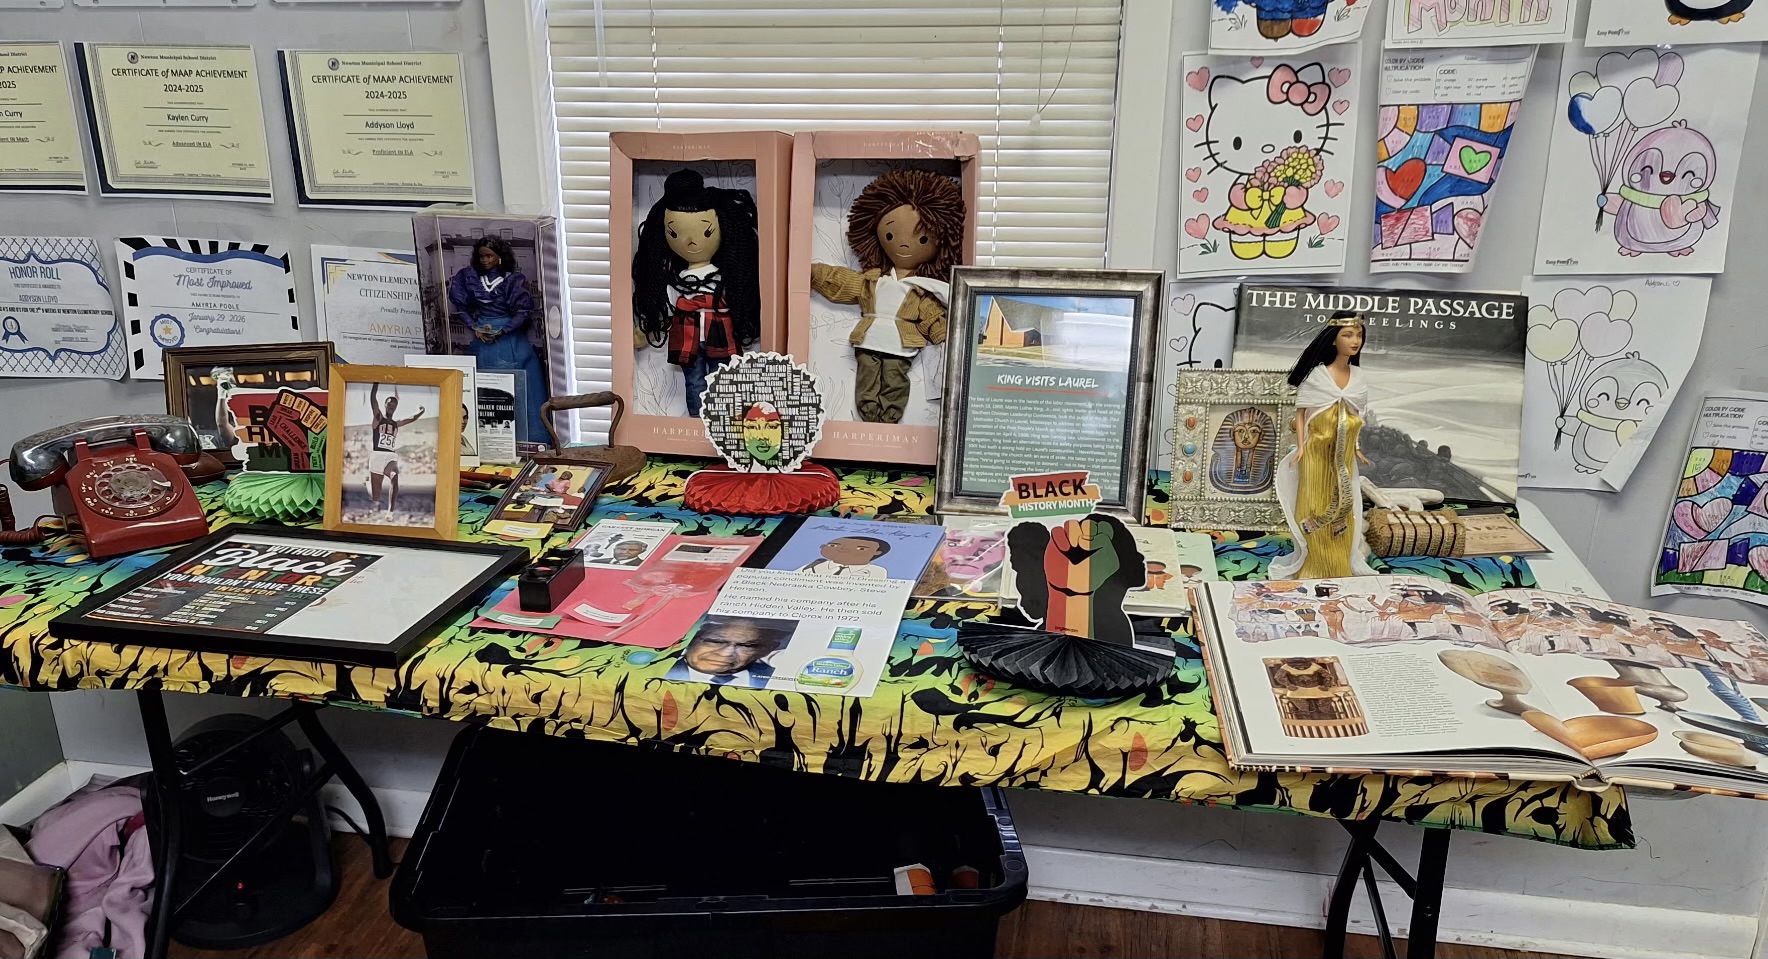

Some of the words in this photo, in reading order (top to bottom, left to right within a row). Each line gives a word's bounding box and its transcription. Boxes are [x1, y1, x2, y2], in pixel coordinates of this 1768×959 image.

[8, 65, 58, 77] ACHIEVEMENT
[111, 68, 159, 77] CERTIFICATE
[161, 69, 169, 79] of
[170, 69, 193, 78] MAAP
[195, 70, 248, 79] ACHIEVEMENT
[311, 75, 360, 84] CERTIFICATE
[362, 75, 371, 86] of
[372, 75, 397, 84] MAAP
[398, 75, 454, 85] ACHIEVEMENT
[163, 84, 204, 93] 2024-2025
[364, 91, 407, 100] 2024-2025
[5, 109, 22, 120] Curry
[166, 113, 189, 123] Kaylen
[190, 114, 209, 124] Curry
[364, 120, 394, 130] Addyson
[396, 120, 415, 130] Lloyd
[9, 266, 38, 280] HONOR
[40, 267, 62, 281] ROLL
[185, 267, 224, 276] CERTIFICATE
[173, 274, 205, 289] Most
[206, 277, 253, 292] Improved
[346, 272, 378, 282] NEWTON
[379, 275, 419, 286] ELEMENTA
[359, 287, 413, 301] CITIZENSHIP
[191, 301, 218, 310] AMYRIA
[219, 303, 240, 311] POOLE
[1246, 289, 1298, 309] THE
[1302, 292, 1401, 314] MIDDLE
[1407, 296, 1517, 321] PASSAGE
[188, 312, 215, 324] January
[228, 314, 246, 323] 2026
[1304, 313, 1327, 323] TO
[1368, 316, 1458, 332] EELINGS
[193, 325, 244, 336] Congratulations!
[368, 323, 413, 336] AMYRIA
[765, 364, 787, 373] FRIEND
[733, 373, 760, 382] AMAZING
[997, 373, 1022, 387] KING
[1025, 375, 1056, 387] VISITS
[1058, 376, 1100, 390] LAUREL
[715, 384, 737, 393] FRIEND
[738, 383, 754, 392] LOVE
[751, 393, 774, 402] STRONG
[800, 396, 821, 404] SMART
[808, 406, 817, 433] JUSTICE
[279, 422, 307, 449] CHALLENGE
[652, 426, 704, 438] HARPERI
[833, 430, 919, 445] HARPERIMAN
[1017, 477, 1088, 500] BLACK
[1017, 499, 1058, 512] HISTORY
[1058, 498, 1096, 510] MONTH
[266, 545, 334, 560] WITHOUT
[201, 547, 357, 577] Black
[175, 562, 344, 588] INVENTORS
[736, 573, 772, 581] popular
[774, 575, 823, 583] condiment
[845, 580, 887, 588] invented
[162, 572, 191, 582] YOU
[188, 575, 255, 589] WOULDN'T
[253, 581, 287, 592] HAVE
[286, 585, 330, 597] THESE
[213, 584, 279, 598] INVENTOR
[768, 580, 814, 589] Nebraska
[859, 587, 888, 595] Steve
[739, 594, 772, 602] named
[790, 597, 836, 607] company
[719, 600, 747, 608] ranch
[748, 602, 785, 610] Hidden
[787, 604, 818, 614] Valley.
[837, 607, 859, 615] then
[861, 609, 884, 617] sold
[731, 608, 776, 618] company
[791, 611, 823, 620] Clorox
[811, 667, 848, 677] Ranch
